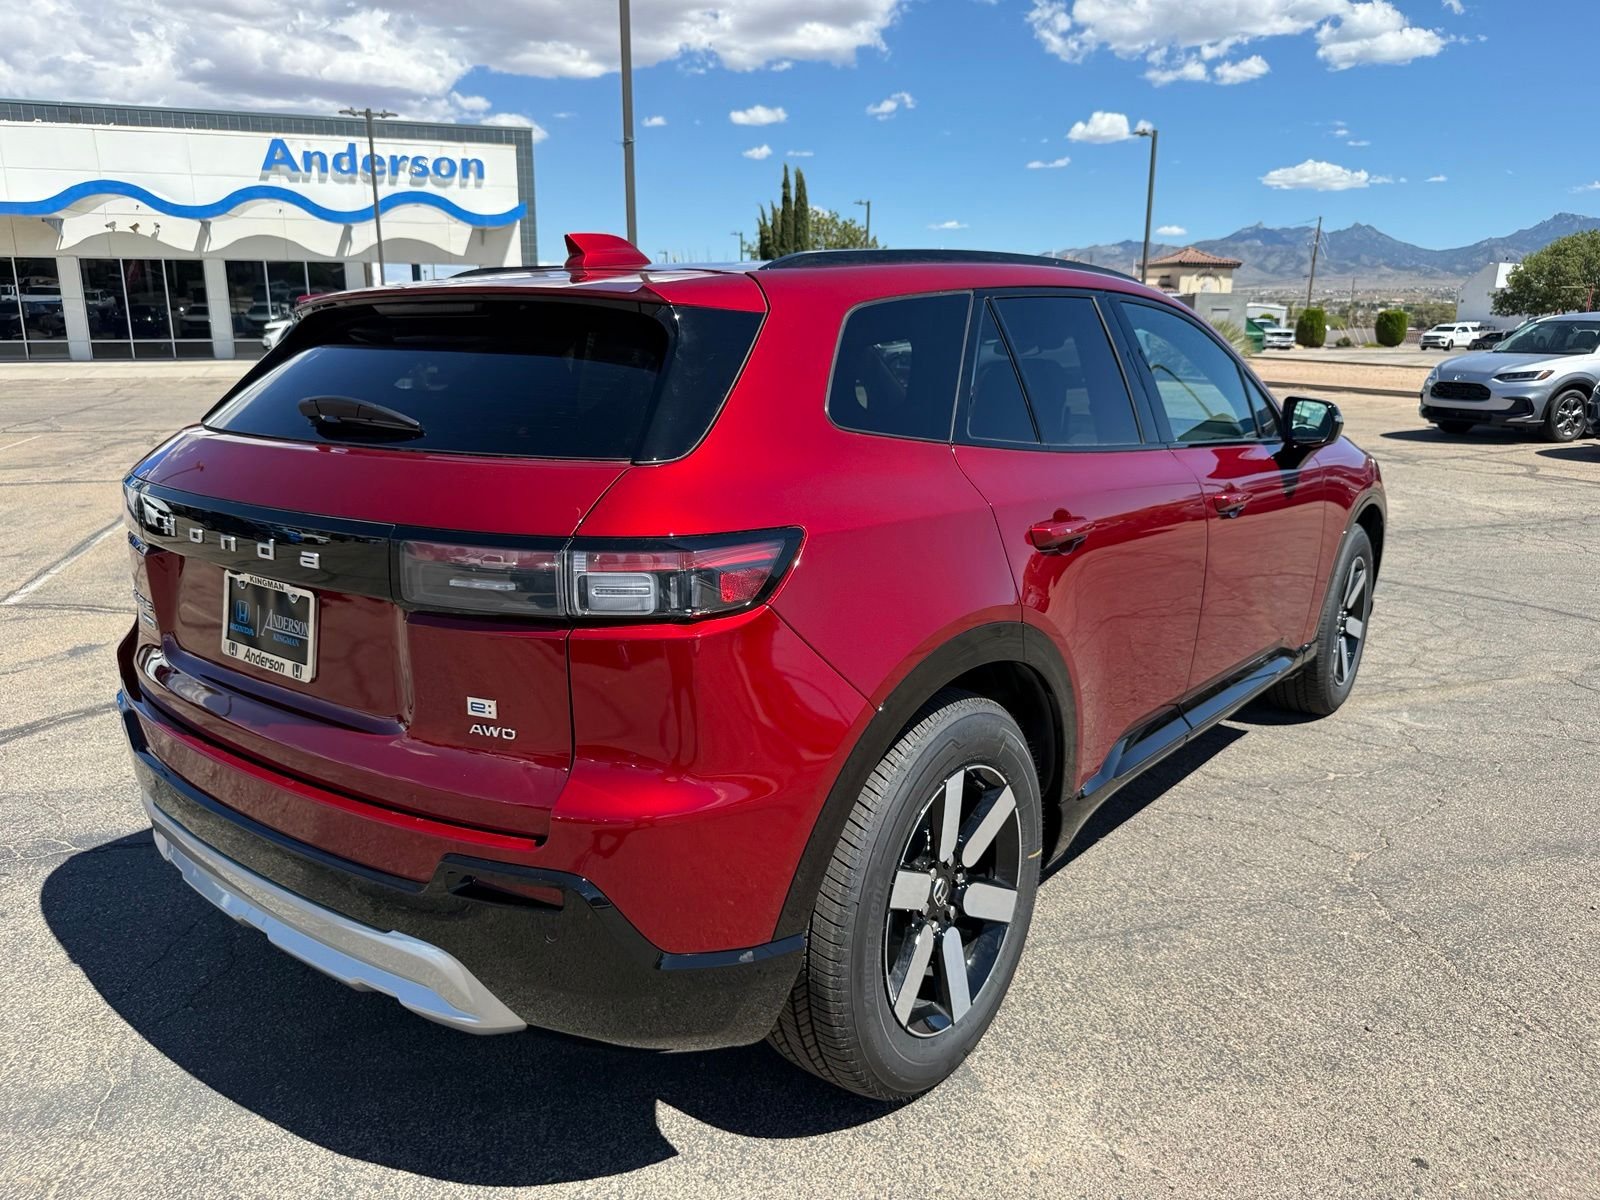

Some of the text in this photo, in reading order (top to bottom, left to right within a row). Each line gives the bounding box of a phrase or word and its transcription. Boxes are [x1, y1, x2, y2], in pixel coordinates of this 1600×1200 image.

[261, 138, 485, 181] Anderson
[163, 513, 321, 570] Honda
[249, 575, 285, 592] KINGMAN
[261, 608, 309, 637] ANDERSON
[243, 648, 285, 674] Anderson
[469, 724, 516, 740] AWD
